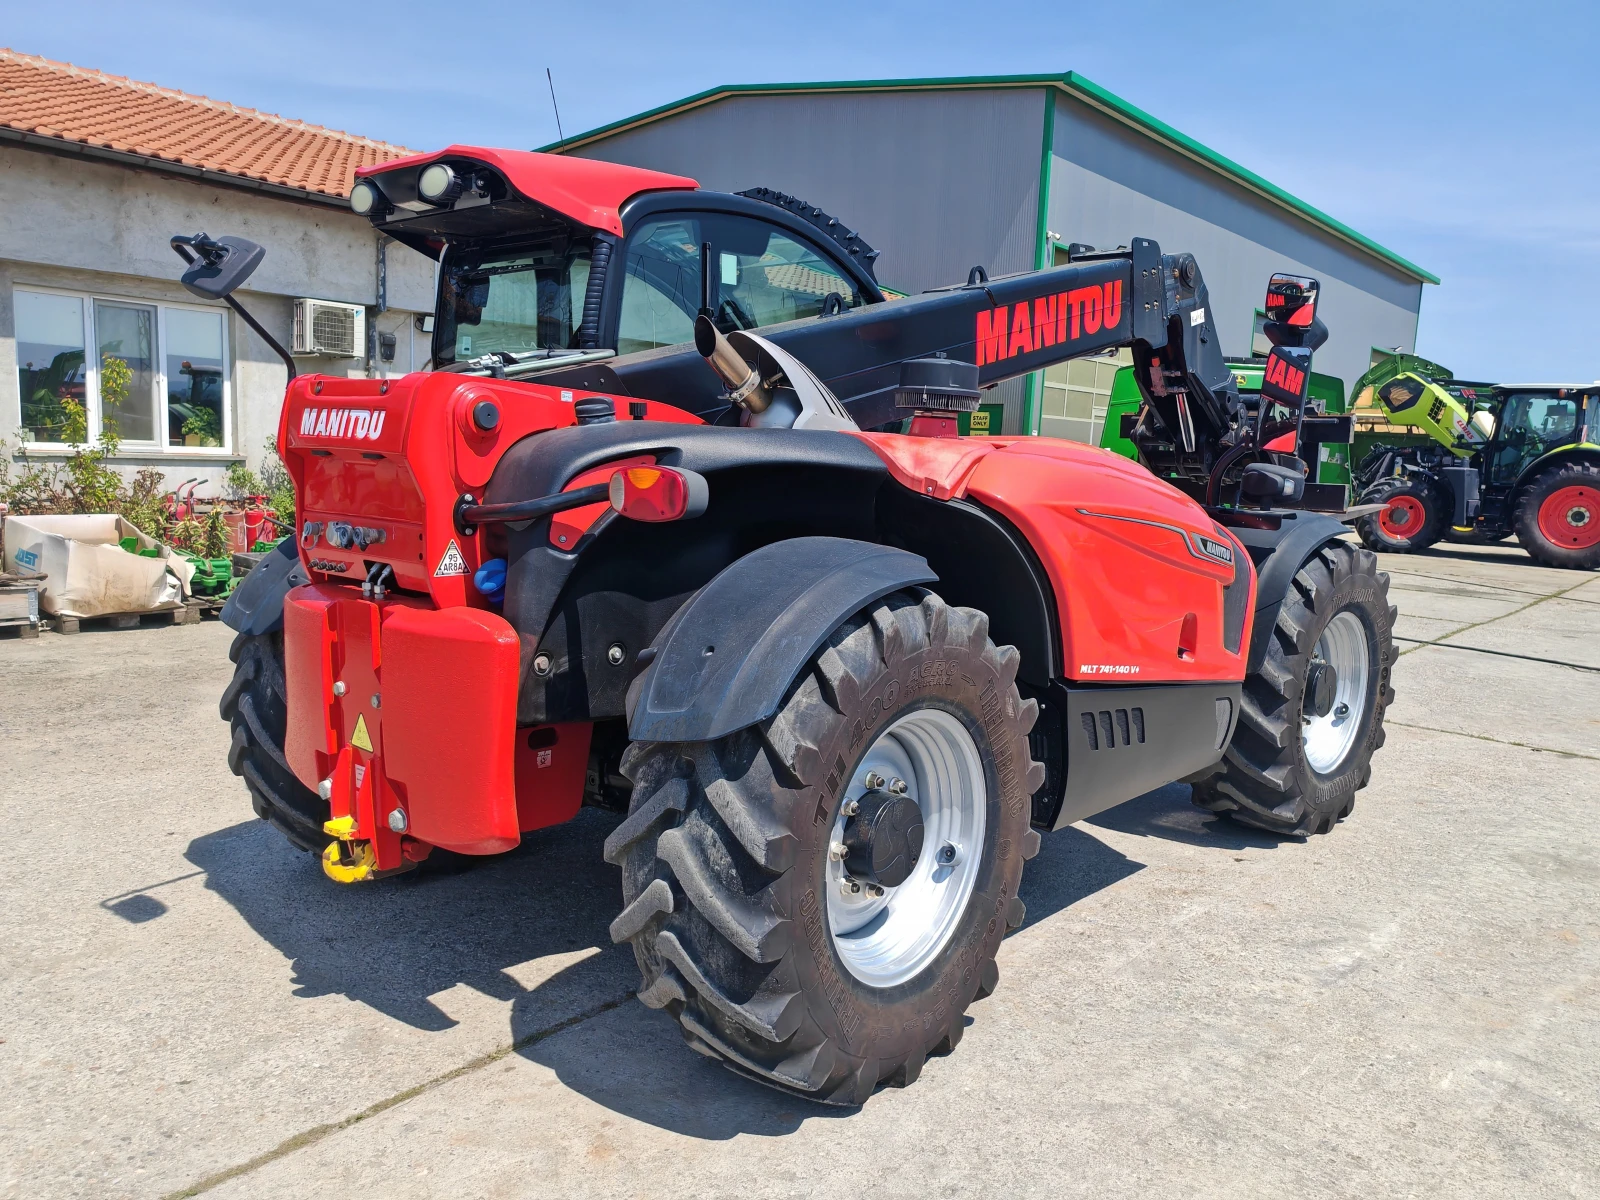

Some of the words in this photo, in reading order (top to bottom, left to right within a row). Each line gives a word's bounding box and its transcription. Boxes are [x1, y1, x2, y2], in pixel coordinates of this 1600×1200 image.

[975, 279, 1123, 367] MANITOU
[300, 407, 386, 440] MANITOU
[1456, 419, 1475, 440] CLAAS
[448, 553, 458, 563] 95
[1206, 540, 1231, 561] MANITOU
[1079, 664, 1098, 674] MLT
[1099, 664, 1130, 674] 741-140
[1130, 665, 1140, 674] V+
[812, 752, 847, 828] TH
[850, 679, 901, 752] 400
[907, 659, 960, 687] AGRO
[979, 676, 1025, 819] TRELLEBORG
[799, 888, 861, 1047] TRELLEBORG
